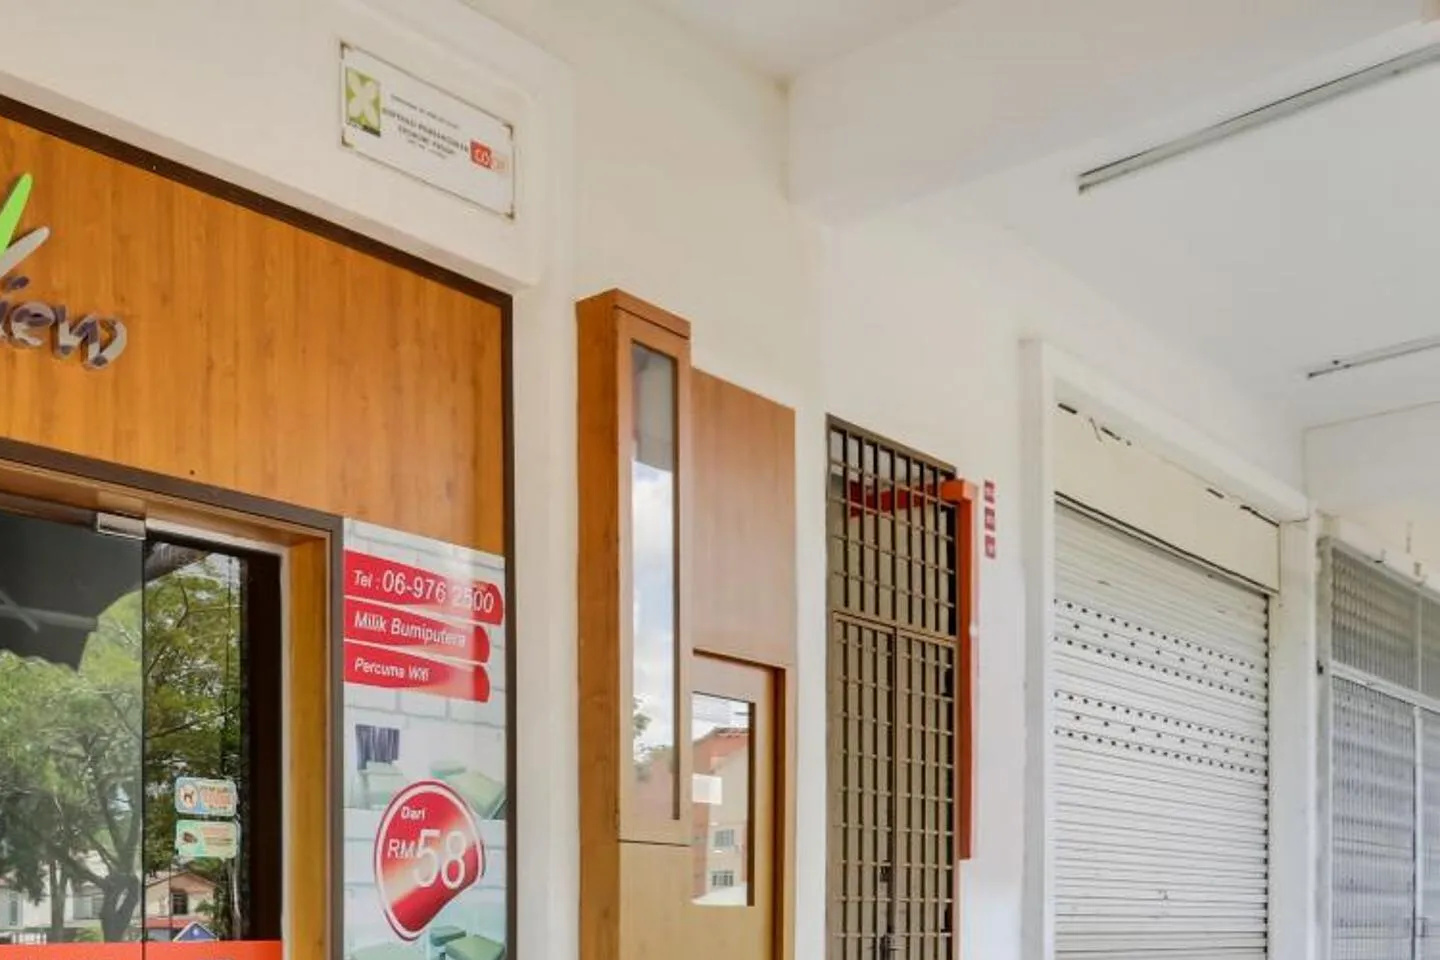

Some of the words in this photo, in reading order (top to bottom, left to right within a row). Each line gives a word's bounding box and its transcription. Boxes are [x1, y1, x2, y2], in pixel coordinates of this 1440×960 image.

[354, 569, 373, 588] Tel
[382, 569, 446, 604] 06-976
[451, 583, 495, 614] 2500
[354, 610, 387, 632] Milik
[391, 617, 466, 648] Bumiputera
[355, 656, 405, 679] Percuma
